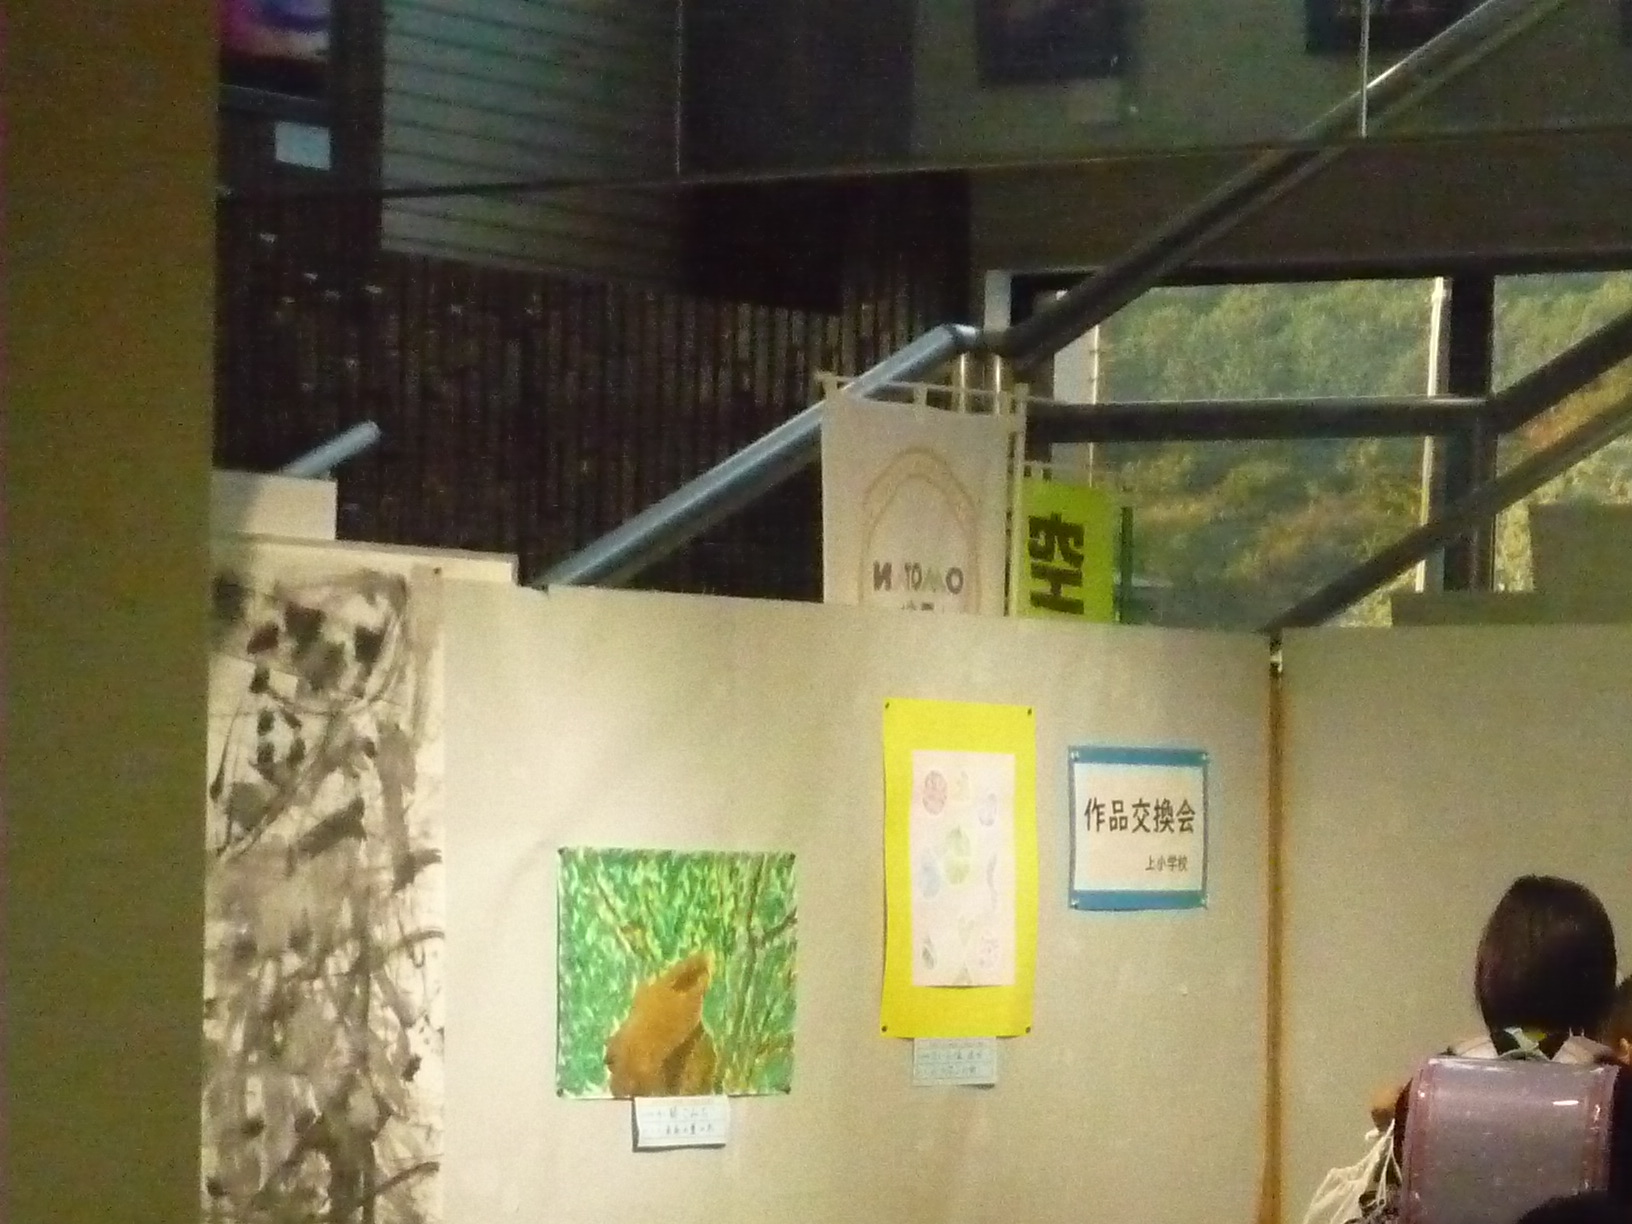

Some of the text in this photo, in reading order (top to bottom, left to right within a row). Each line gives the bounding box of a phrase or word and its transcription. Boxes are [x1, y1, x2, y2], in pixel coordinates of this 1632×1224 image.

[1084, 797, 1196, 834] 作品交換会
